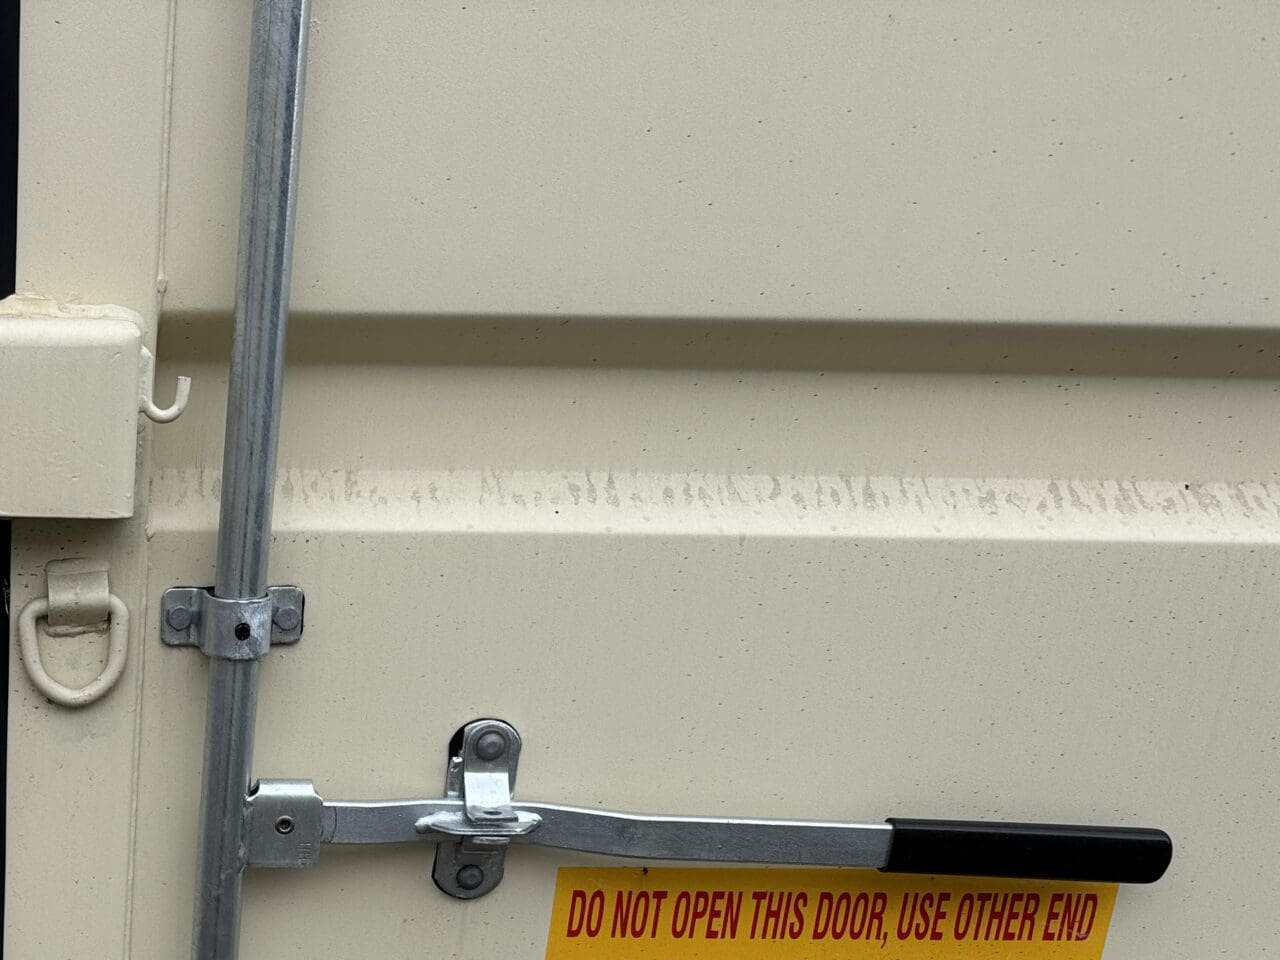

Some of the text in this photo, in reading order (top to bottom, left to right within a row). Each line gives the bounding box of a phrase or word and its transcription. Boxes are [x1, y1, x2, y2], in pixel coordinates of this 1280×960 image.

[566, 888, 1099, 950] DO NOT OPEN THIS DOOR, USE OTHER END
